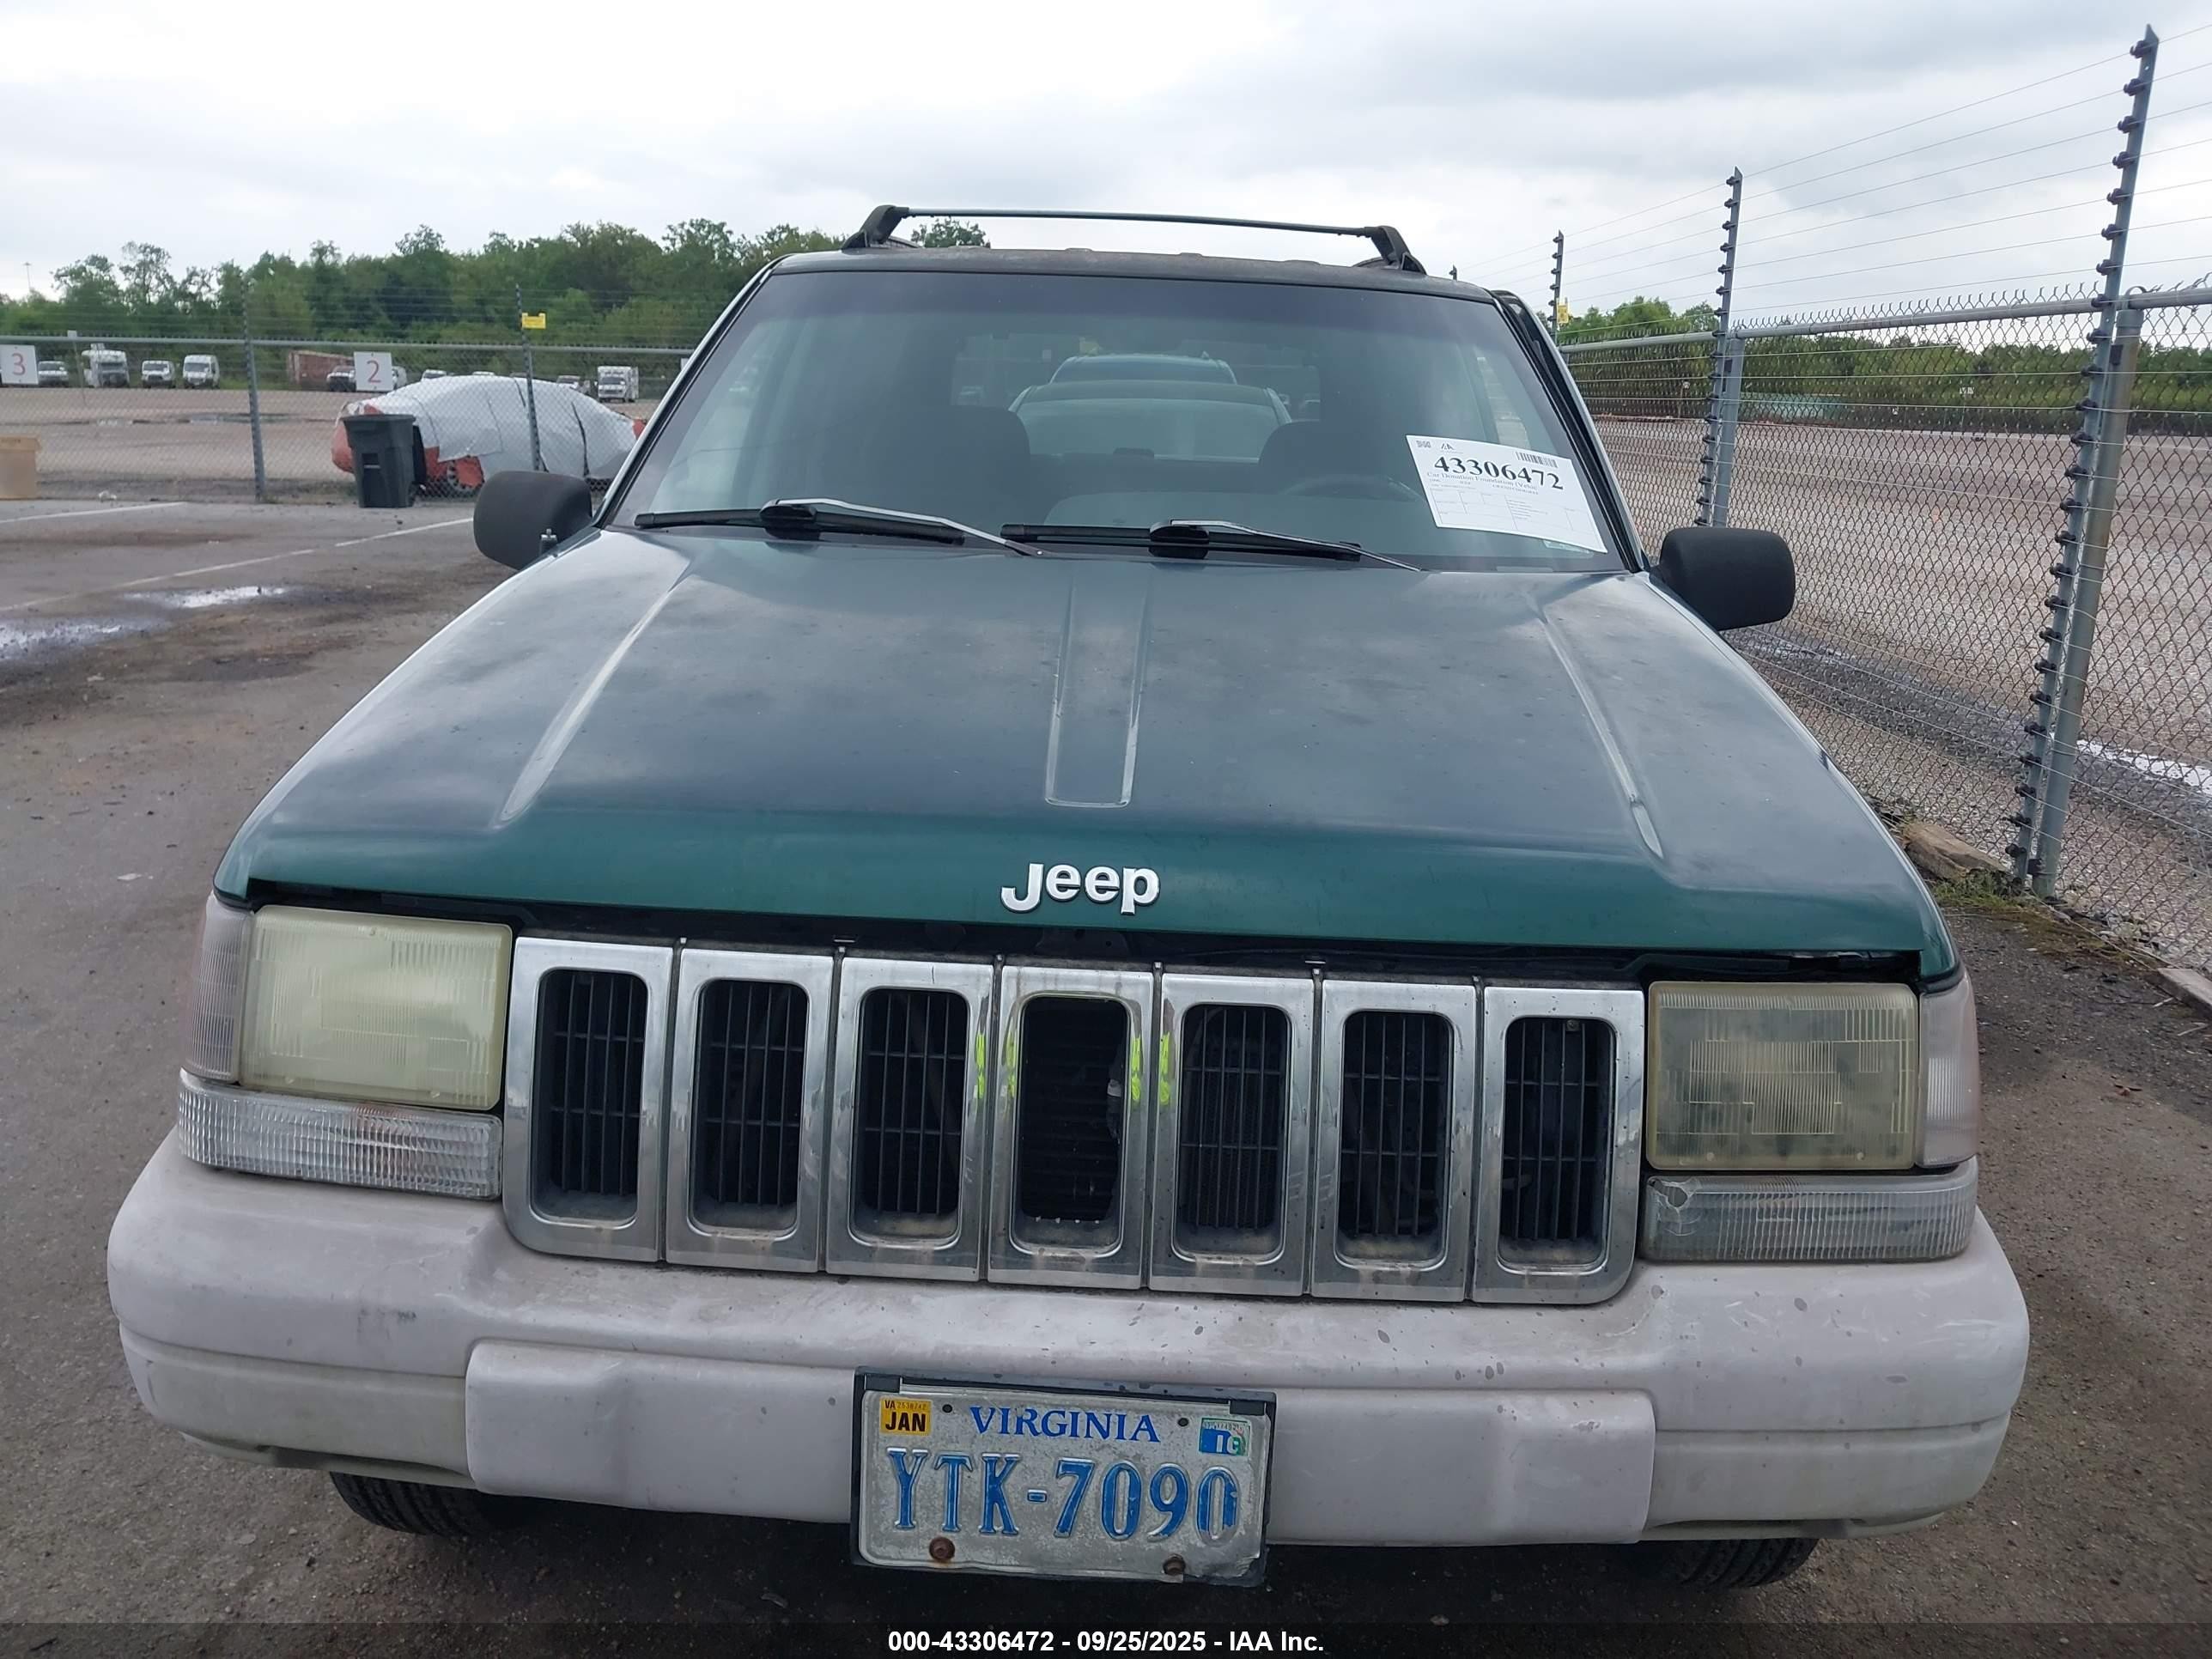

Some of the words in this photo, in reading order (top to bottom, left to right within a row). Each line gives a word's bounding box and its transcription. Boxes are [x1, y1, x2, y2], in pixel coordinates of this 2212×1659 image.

[11, 352, 26, 376] 3
[366, 359, 382, 384] 2
[1434, 456, 1564, 489] 43306472
[1000, 862, 1159, 915] Jeep
[884, 1399, 896, 1410] VA
[884, 1411, 926, 1432] JAN
[970, 1406, 1161, 1443] VIRGINIA
[886, 1447, 1240, 1545] YTK-7090
